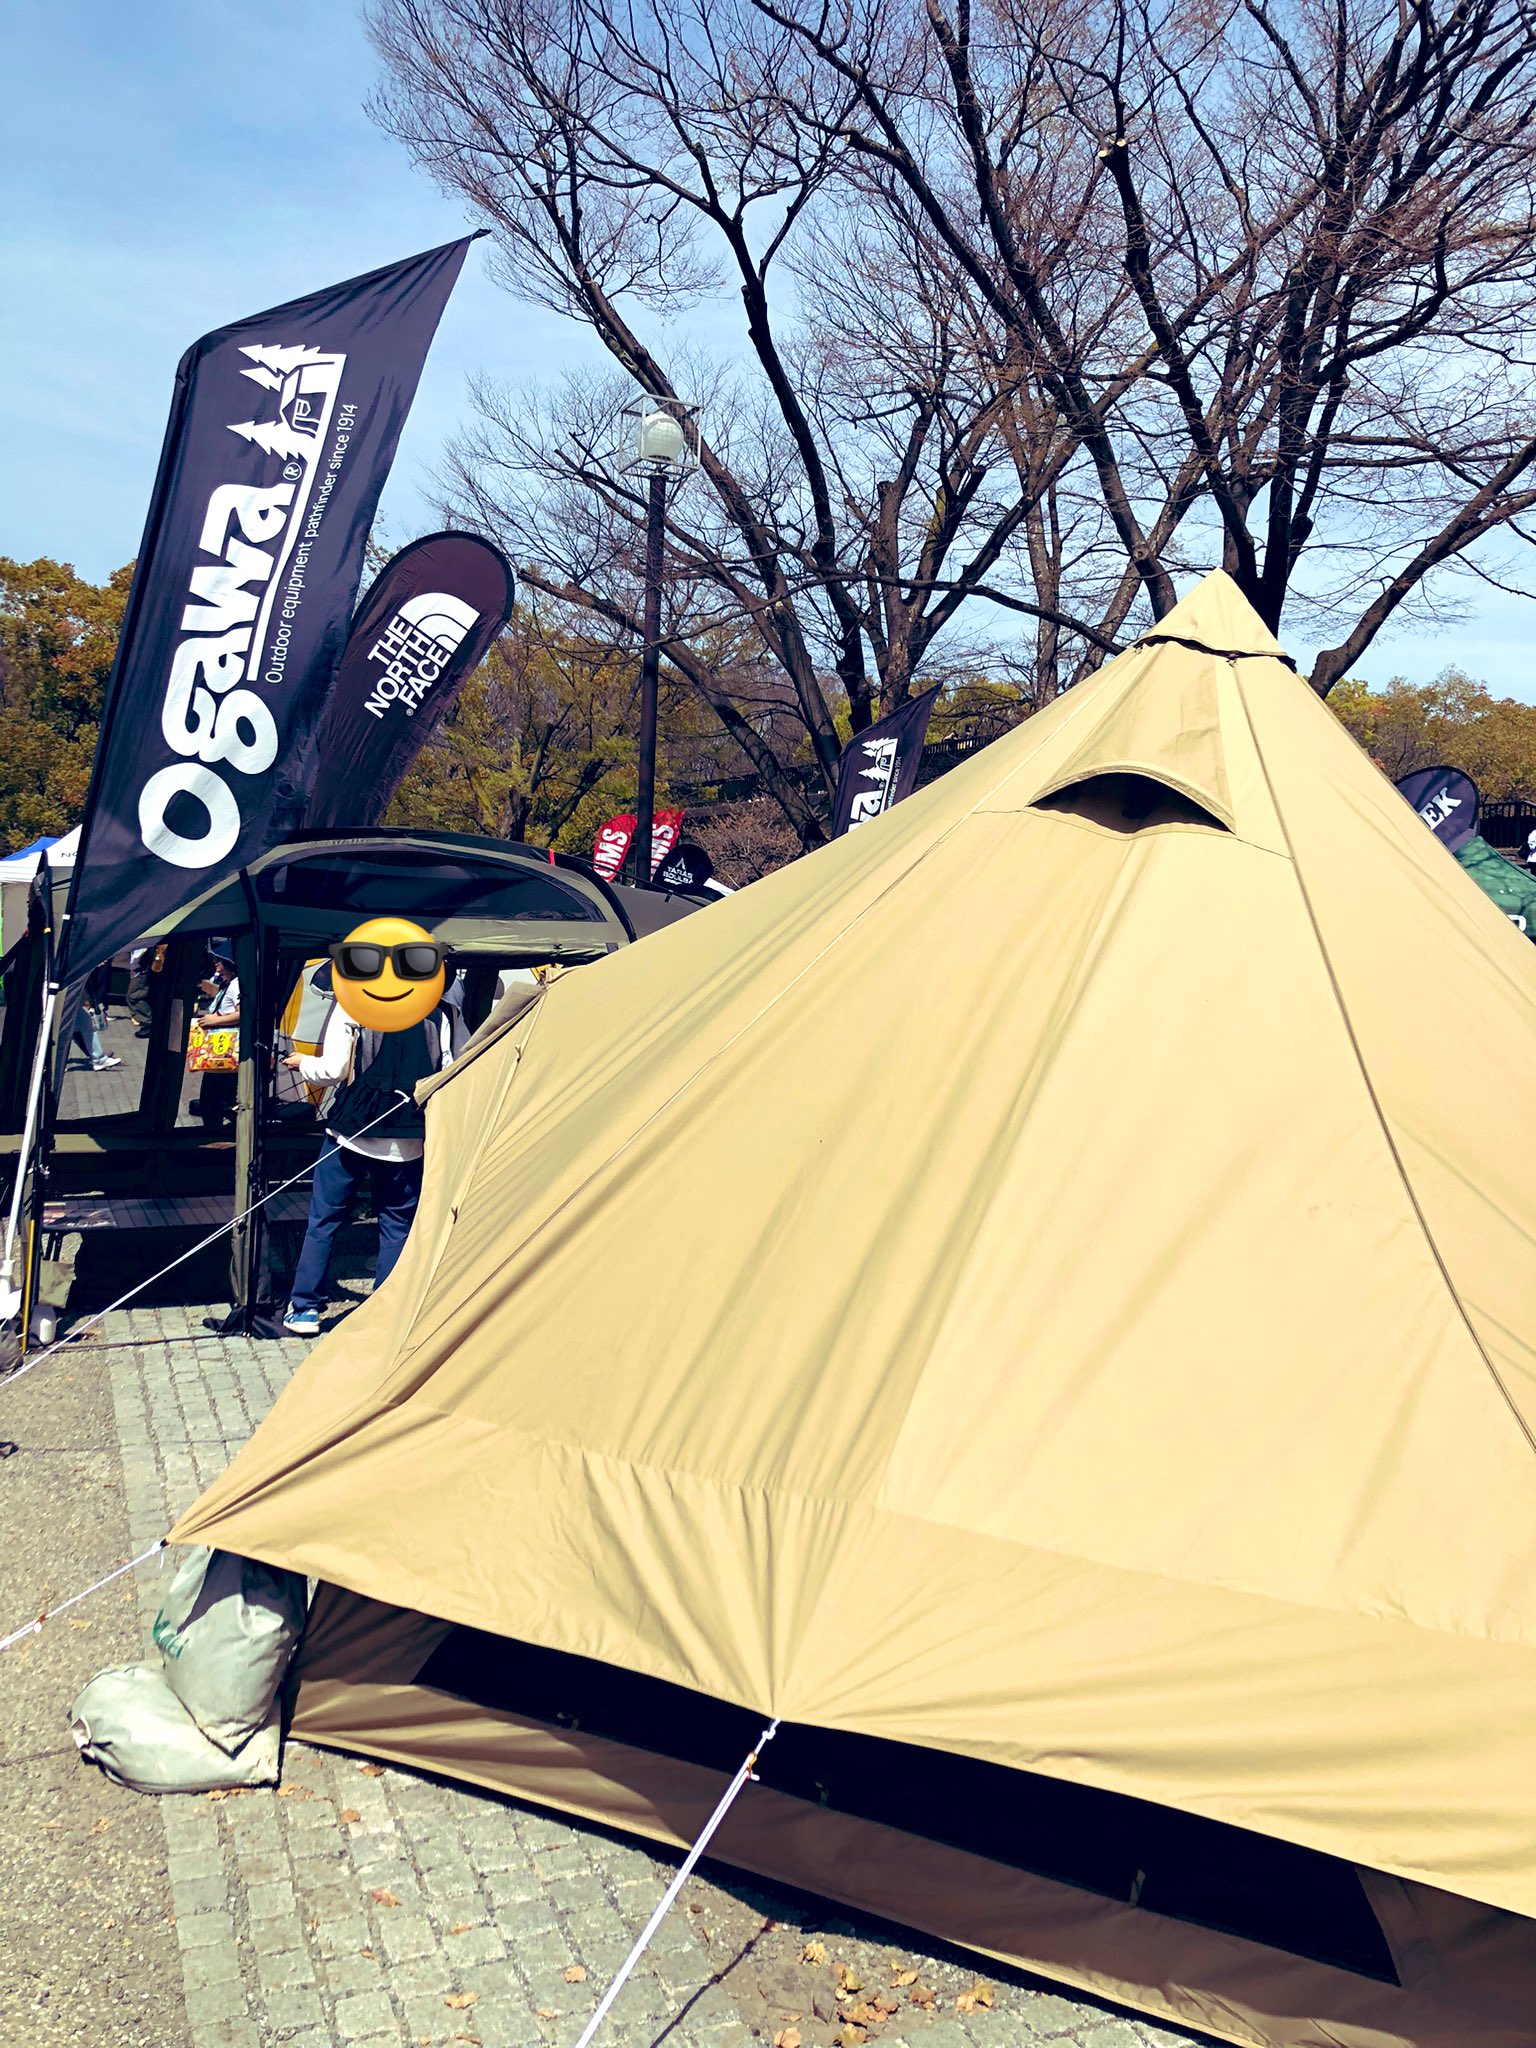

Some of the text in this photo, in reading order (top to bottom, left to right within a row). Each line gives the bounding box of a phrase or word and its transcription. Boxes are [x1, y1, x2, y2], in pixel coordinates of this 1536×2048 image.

[265, 404, 359, 684] Outdoor equipment pathfinder since 1914
[363, 629, 433, 719] NORTH
[367, 615, 414, 666] THE
[397, 643, 452, 710] FACE
